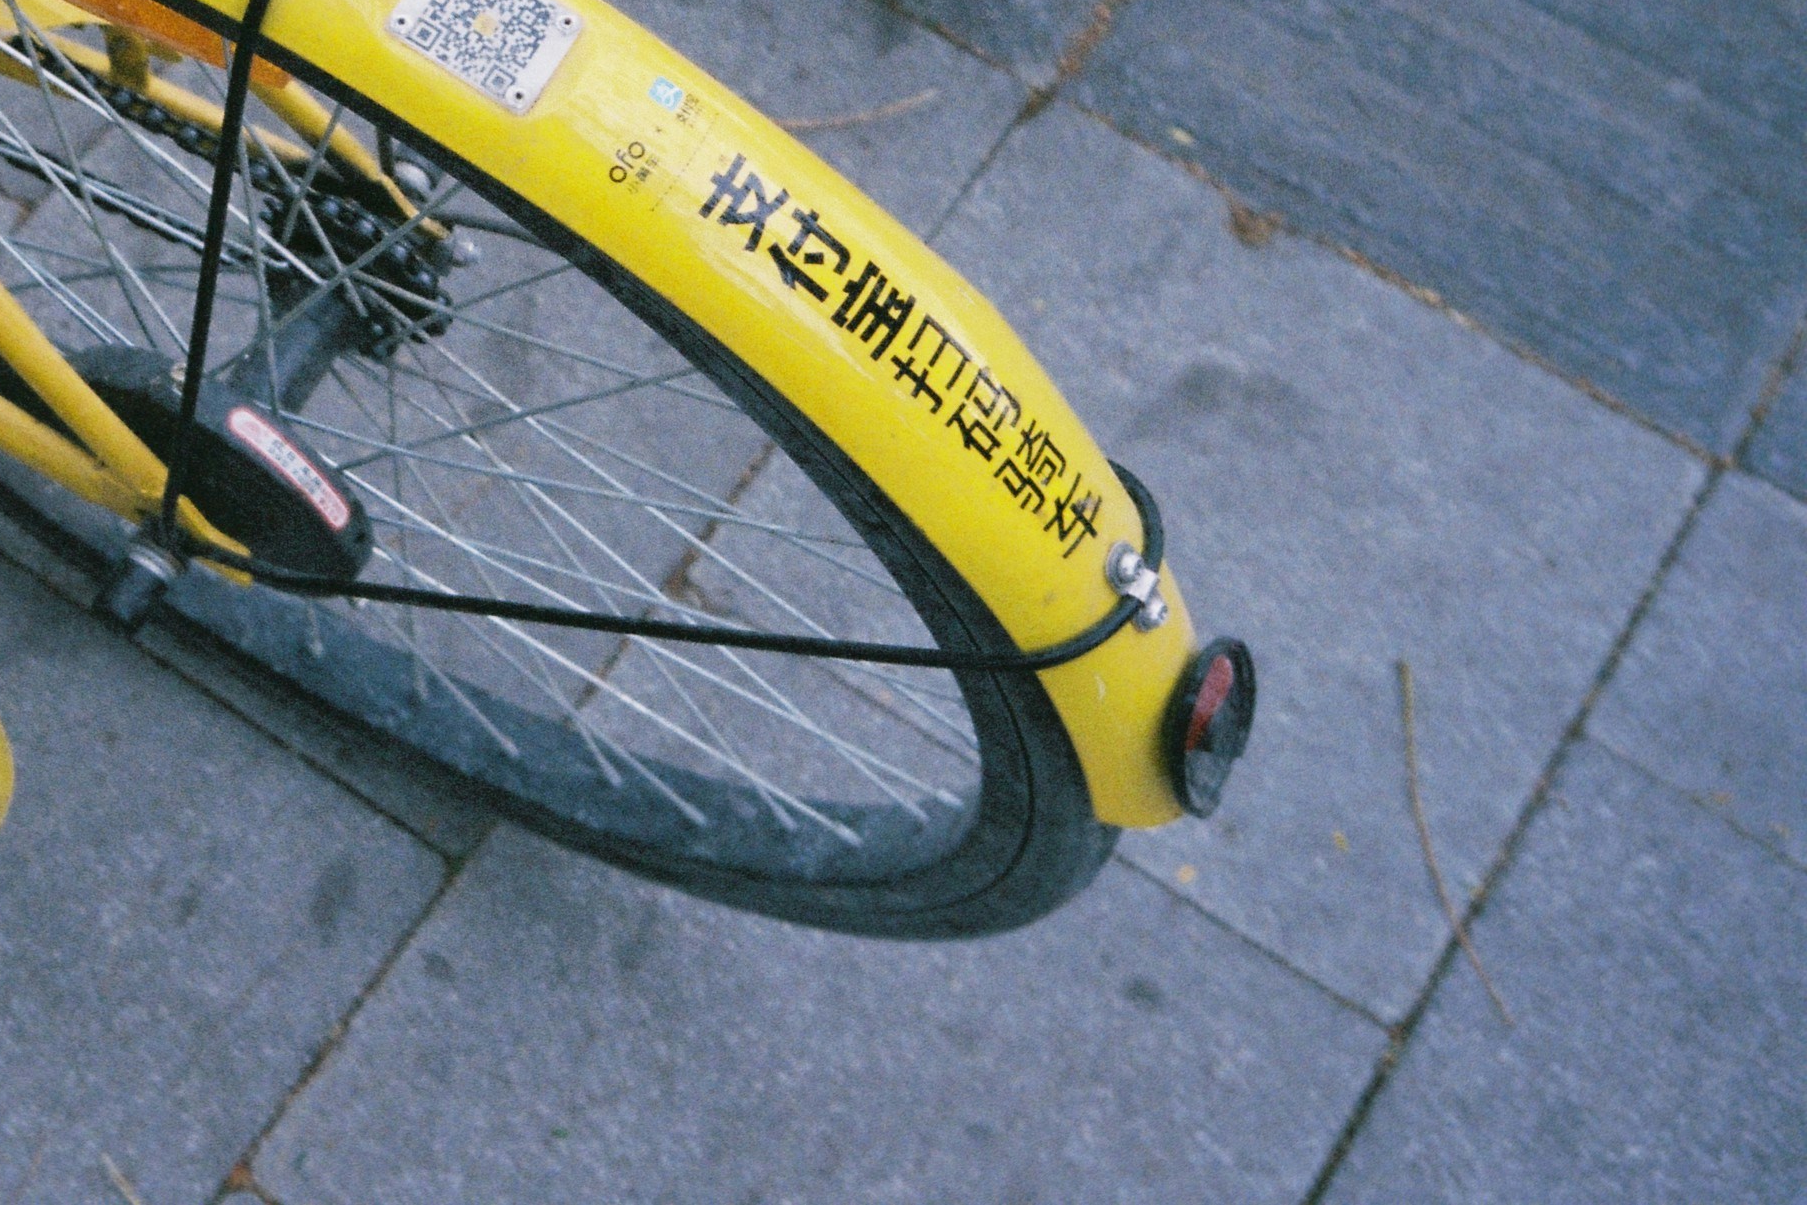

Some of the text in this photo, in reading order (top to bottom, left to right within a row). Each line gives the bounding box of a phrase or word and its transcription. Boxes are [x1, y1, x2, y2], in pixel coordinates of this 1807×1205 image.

[608, 141, 645, 184] ofo
[699, 151, 1104, 559] 支付宝扫码骑车
